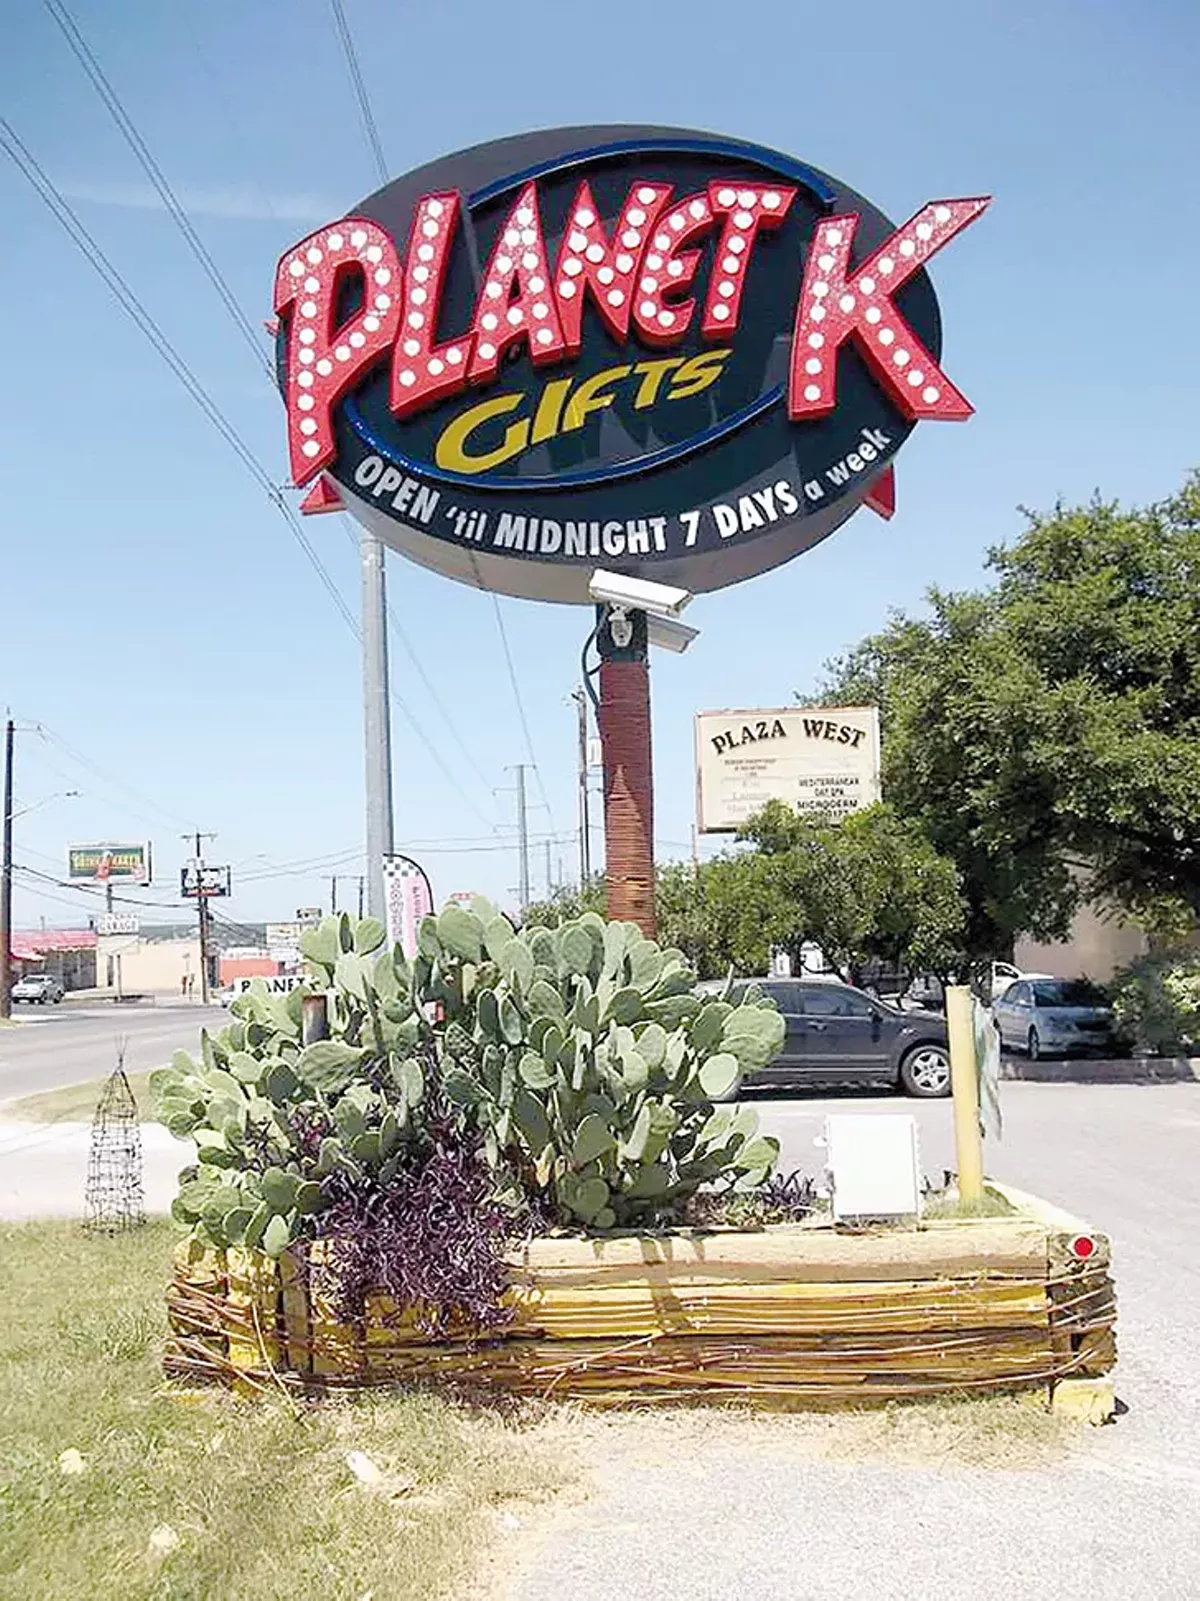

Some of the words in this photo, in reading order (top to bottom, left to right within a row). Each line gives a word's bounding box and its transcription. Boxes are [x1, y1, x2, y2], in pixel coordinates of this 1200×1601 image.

[274, 180, 787, 485] PLANET
[788, 195, 992, 421] K
[435, 348, 733, 474] GIFTS
[354, 455, 441, 524] OPEN
[446, 506, 488, 542] 'til
[493, 513, 667, 556] MIDNIGHT
[679, 510, 700, 547] 7
[712, 481, 798, 539] DAYS
[803, 479, 823, 501] a
[826, 428, 892, 487] week
[711, 719, 787, 755] PLAZA
[802, 719, 866, 749] WEST
[240, 977, 306, 993] PNET
